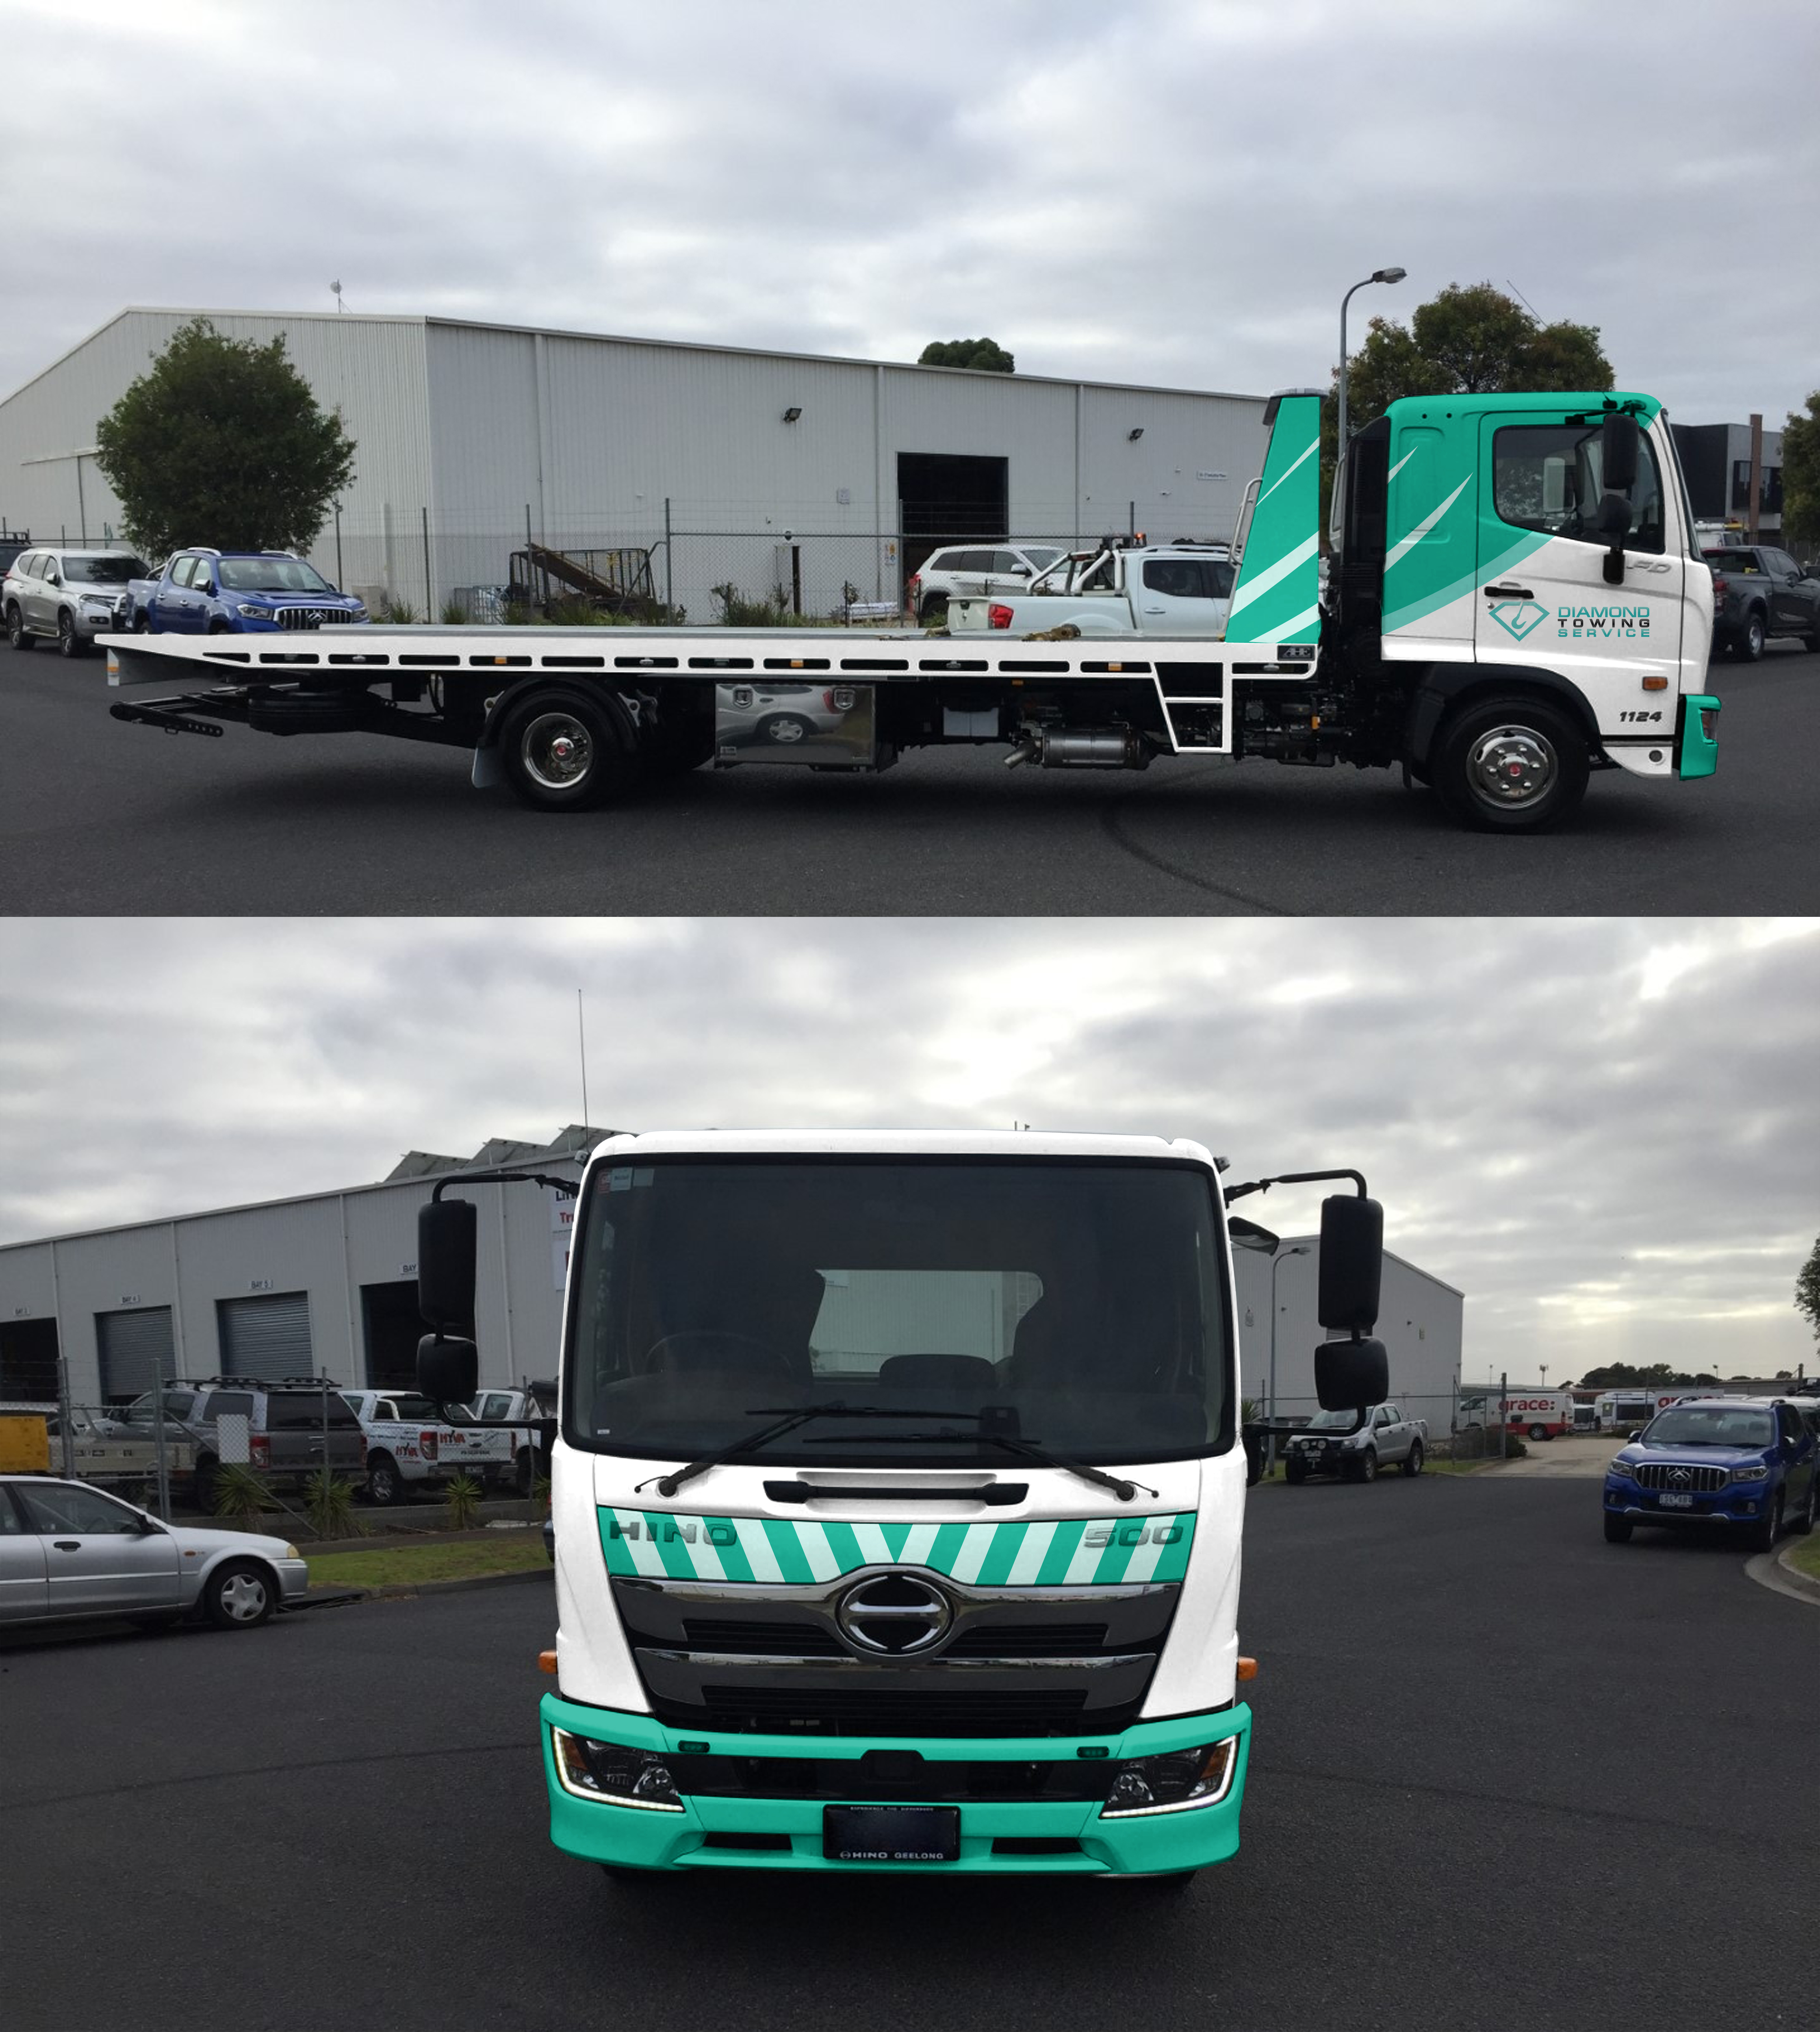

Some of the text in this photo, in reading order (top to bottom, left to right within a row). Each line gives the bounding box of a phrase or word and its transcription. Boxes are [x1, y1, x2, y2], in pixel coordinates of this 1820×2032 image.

[1558, 606, 1650, 618] DIAMOND
[1558, 619, 1650, 628] TOWING
[1558, 628, 1650, 637] SERVICE
[1620, 711, 1662, 722] 1124
[403, 1263, 416, 1272] BAY
[251, 1280, 263, 1289] BAY
[440, 1430, 466, 1443] HYVA
[610, 1521, 738, 1546] HINO
[1084, 1526, 1184, 1548] 500
